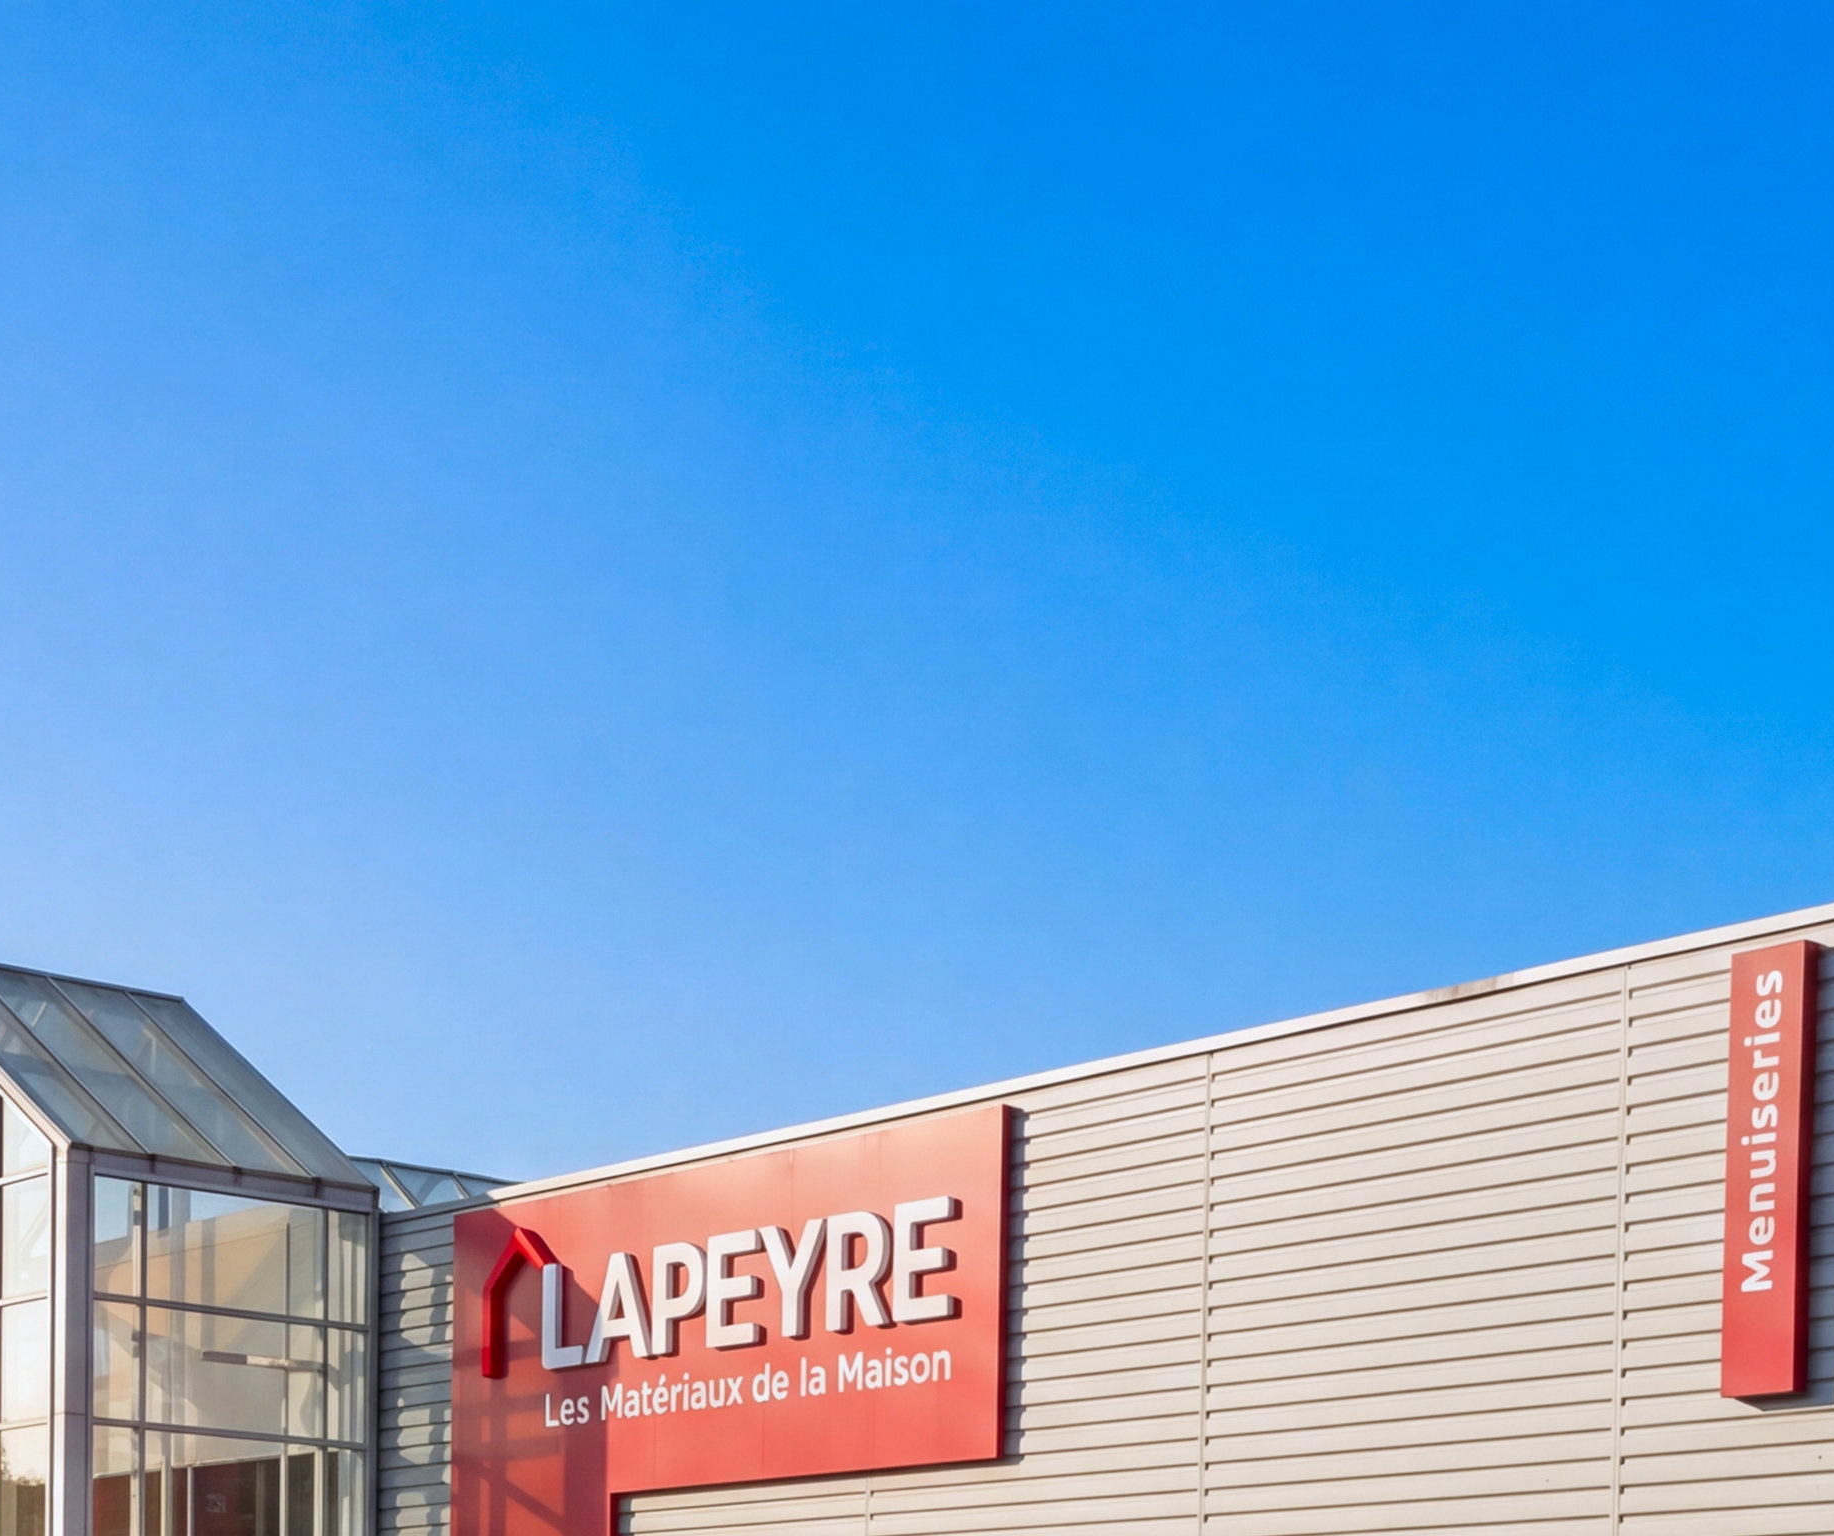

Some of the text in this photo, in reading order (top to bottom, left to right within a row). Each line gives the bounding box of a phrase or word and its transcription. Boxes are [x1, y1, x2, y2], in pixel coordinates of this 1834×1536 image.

[1741, 969, 1783, 1292] Menuiseries
[542, 1195, 955, 1370] LAPEYRE
[544, 1347, 952, 1428] Les Matériaux de la Maison
